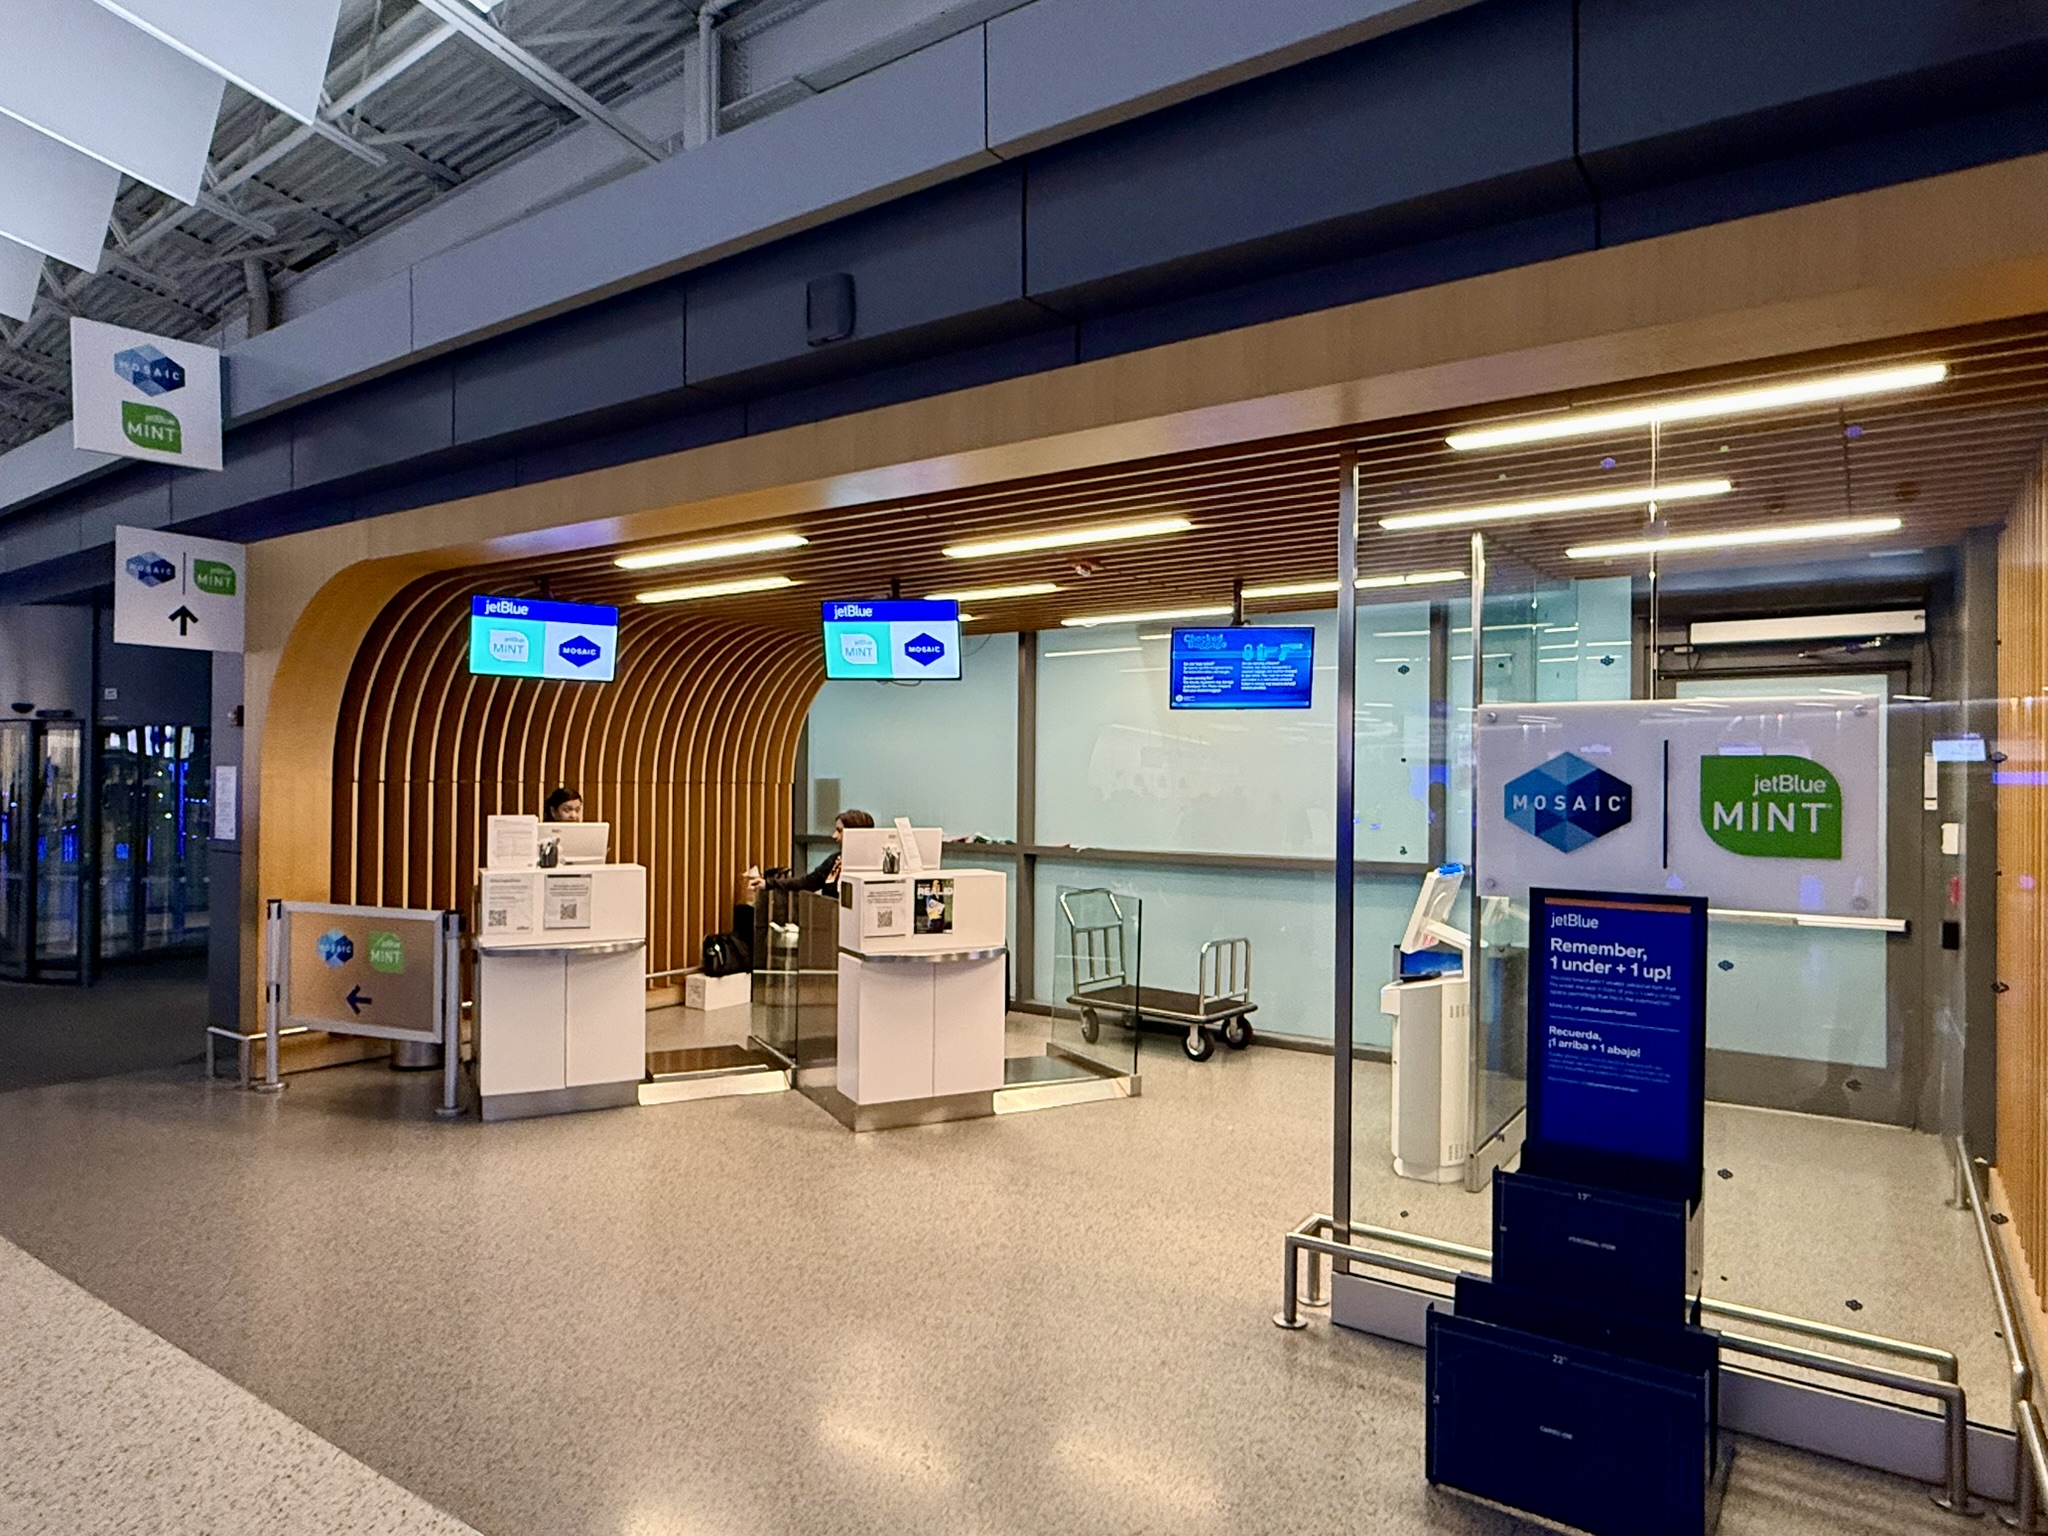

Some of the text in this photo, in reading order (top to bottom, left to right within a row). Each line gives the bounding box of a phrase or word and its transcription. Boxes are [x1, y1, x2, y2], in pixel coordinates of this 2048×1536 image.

[119, 361, 180, 380] MOSAIC
[127, 421, 176, 442] MINT
[129, 563, 172, 576] MOSAIC
[197, 573, 232, 589] MINT
[484, 600, 529, 615] jetBlue
[834, 605, 873, 620] jetBlue
[493, 643, 525, 655] MINT
[562, 646, 597, 656] MOSAIC
[845, 647, 873, 658] MINT
[908, 645, 941, 654] MOSAIC
[1752, 774, 1827, 797] jetBlue
[1513, 794, 1621, 812] MOSAIC
[1713, 801, 1827, 833] MINT
[1550, 912, 1599, 929] jetBlue
[370, 949, 401, 963] MINT
[1550, 937, 1648, 962] Remember,
[1550, 955, 1672, 983] 1 under + 1 up!
[1548, 1025, 1602, 1042] Recuerda,
[1558, 1039, 1589, 1051] arriba
[1591, 1043, 1598, 1051] +
[1599, 1043, 1605, 1053] 1
[1607, 1045, 1641, 1059] abajo!
